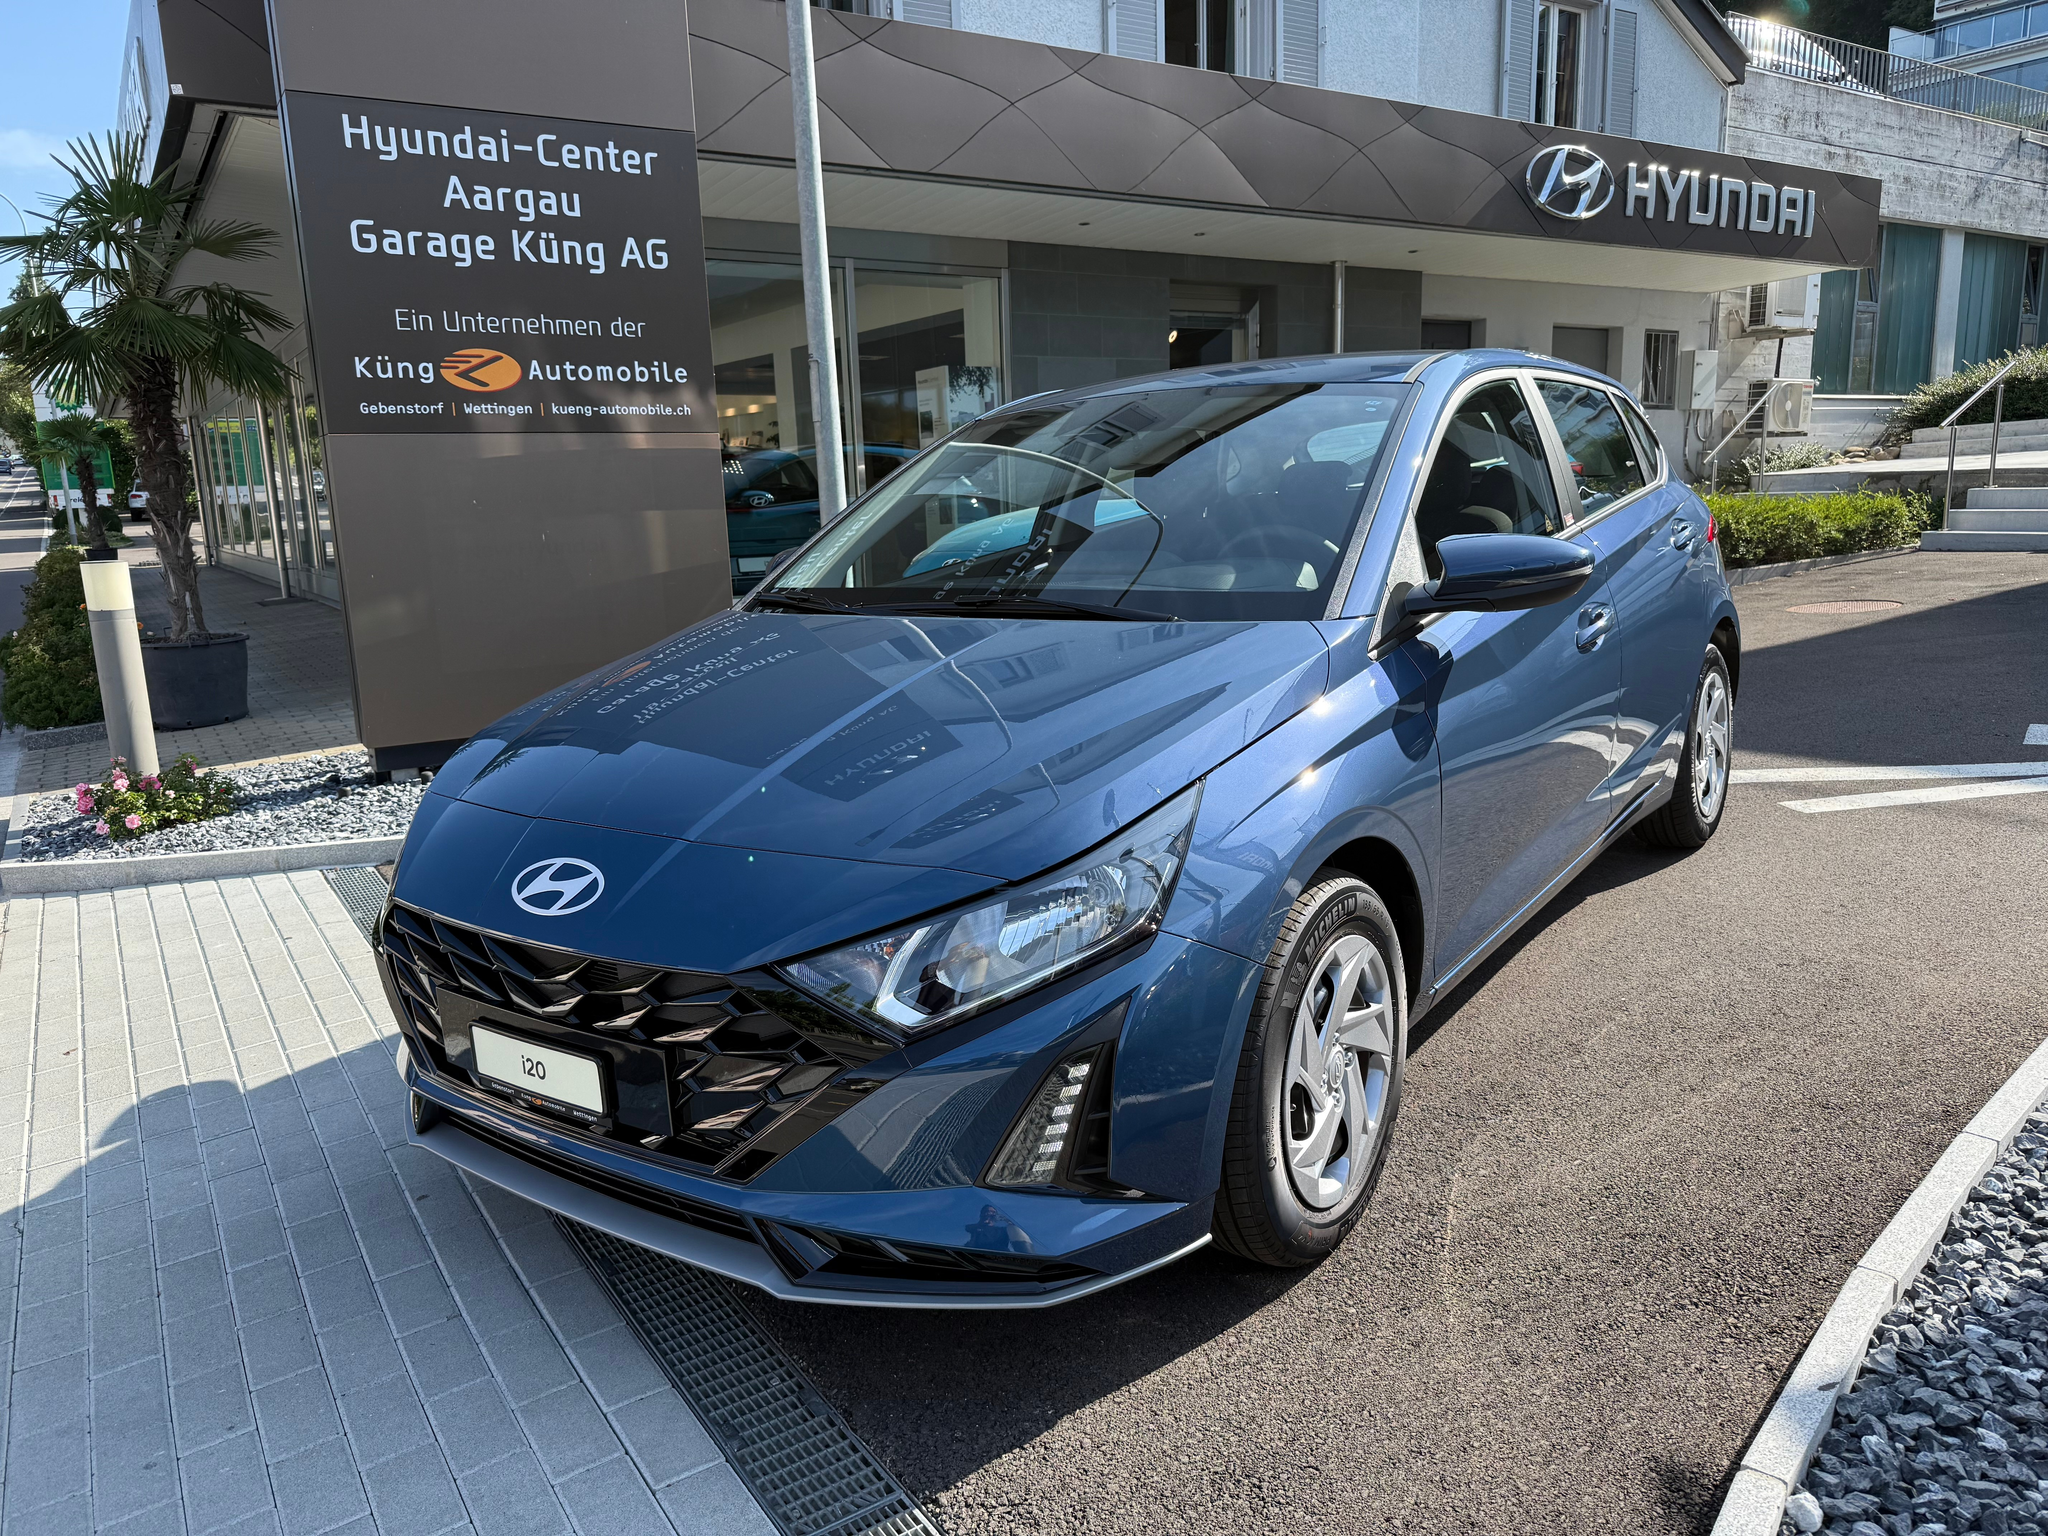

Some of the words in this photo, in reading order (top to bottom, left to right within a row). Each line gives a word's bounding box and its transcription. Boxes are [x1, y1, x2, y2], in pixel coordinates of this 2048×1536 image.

[341, 113, 658, 176] Hyundai-Center
[443, 175, 581, 222] Aargau
[1625, 162, 1816, 238] HYUNDAI
[350, 219, 495, 267] Garage
[511, 229, 606, 274] Küng
[620, 237, 669, 270] AG
[395, 308, 433, 332] Ein
[443, 310, 602, 337] Unternehmen
[610, 316, 646, 338] der
[354, 356, 434, 384] Küng
[528, 359, 688, 384] Automobile
[359, 401, 444, 416] Gebenstorf
[463, 402, 533, 416] Wettingen
[551, 402, 692, 417] kueng-automobile.ch
[1304, 896, 1356, 961] MICHELIN
[521, 1054, 546, 1081] i20
